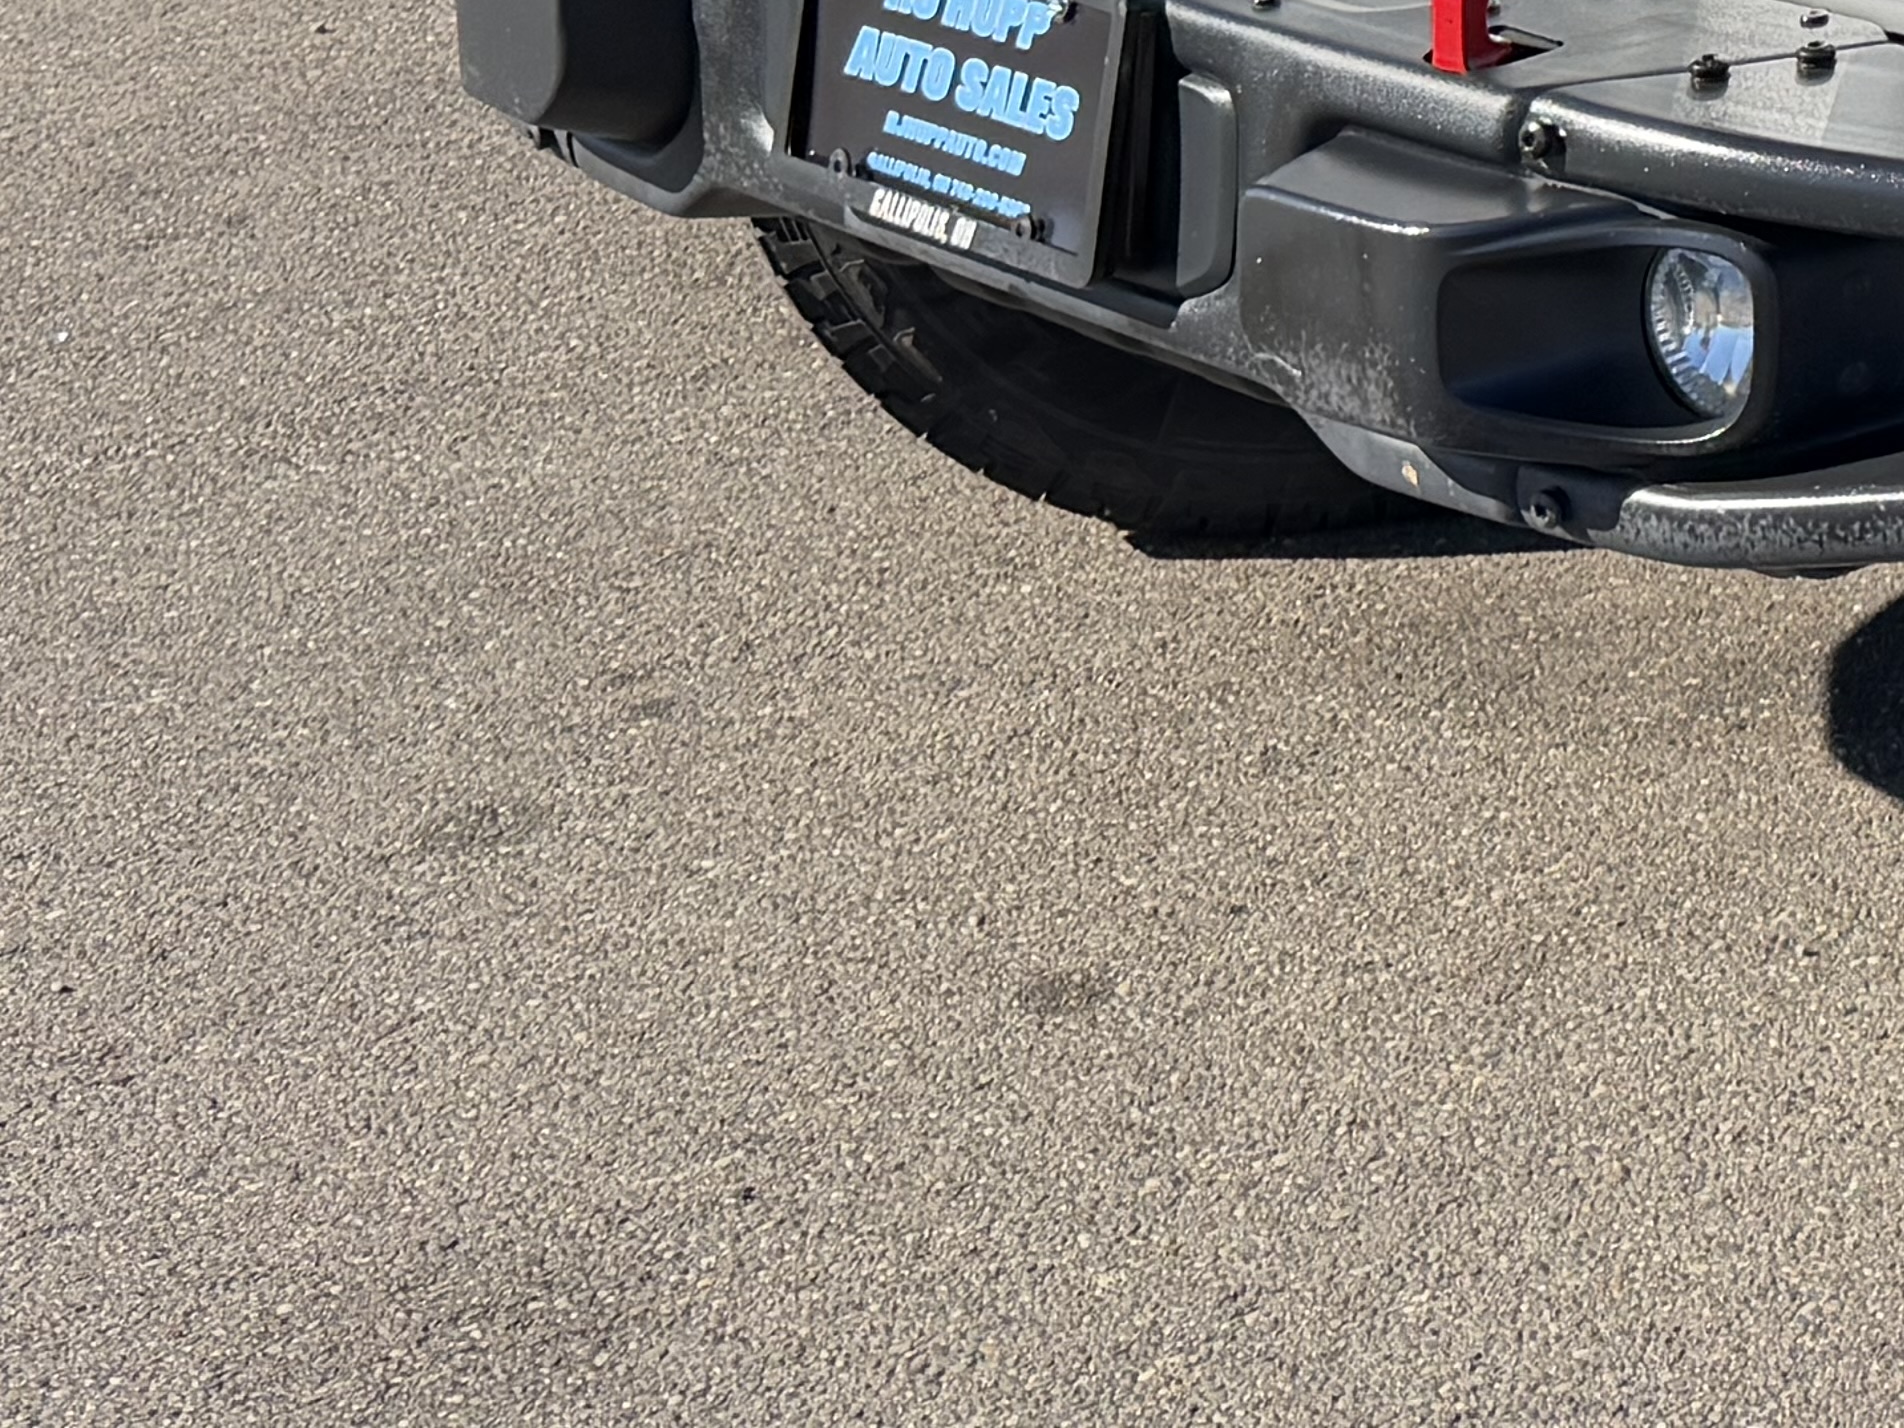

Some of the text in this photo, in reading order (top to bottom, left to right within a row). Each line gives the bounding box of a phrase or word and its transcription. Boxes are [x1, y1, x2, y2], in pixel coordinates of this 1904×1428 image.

[843, 24, 1080, 141] AUTO SALES
[868, 187, 950, 245] GALLIPOLIS,
[950, 216, 978, 250] OH
